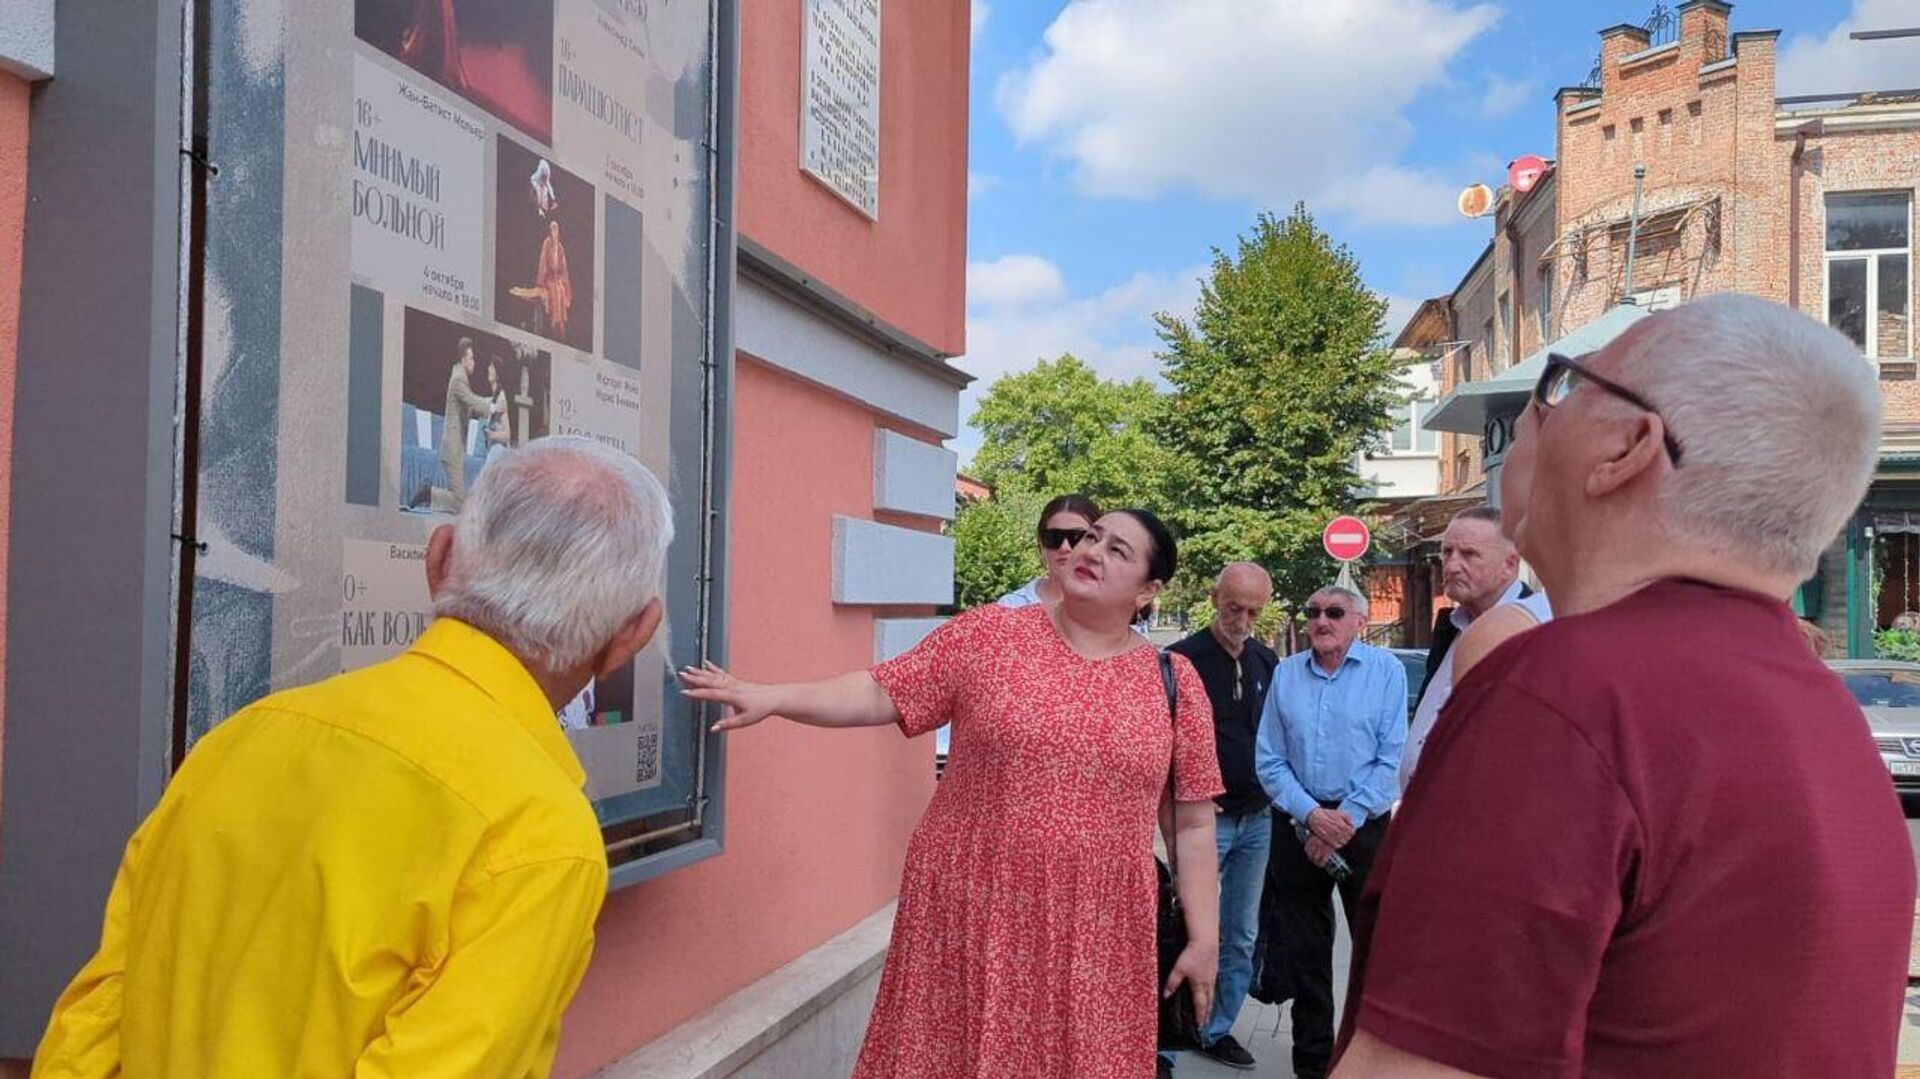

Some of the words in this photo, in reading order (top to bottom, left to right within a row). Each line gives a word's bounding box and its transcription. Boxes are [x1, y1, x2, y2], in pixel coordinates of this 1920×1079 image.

[355, 98, 383, 128] 16+
[353, 129, 442, 203] МНИМЫЙ
[351, 178, 445, 251] БОЛЬНОЙ
[430, 268, 466, 292] октября
[390, 544, 428, 560] Васили
[343, 574, 368, 602] 0+
[342, 610, 376, 646] КАК
